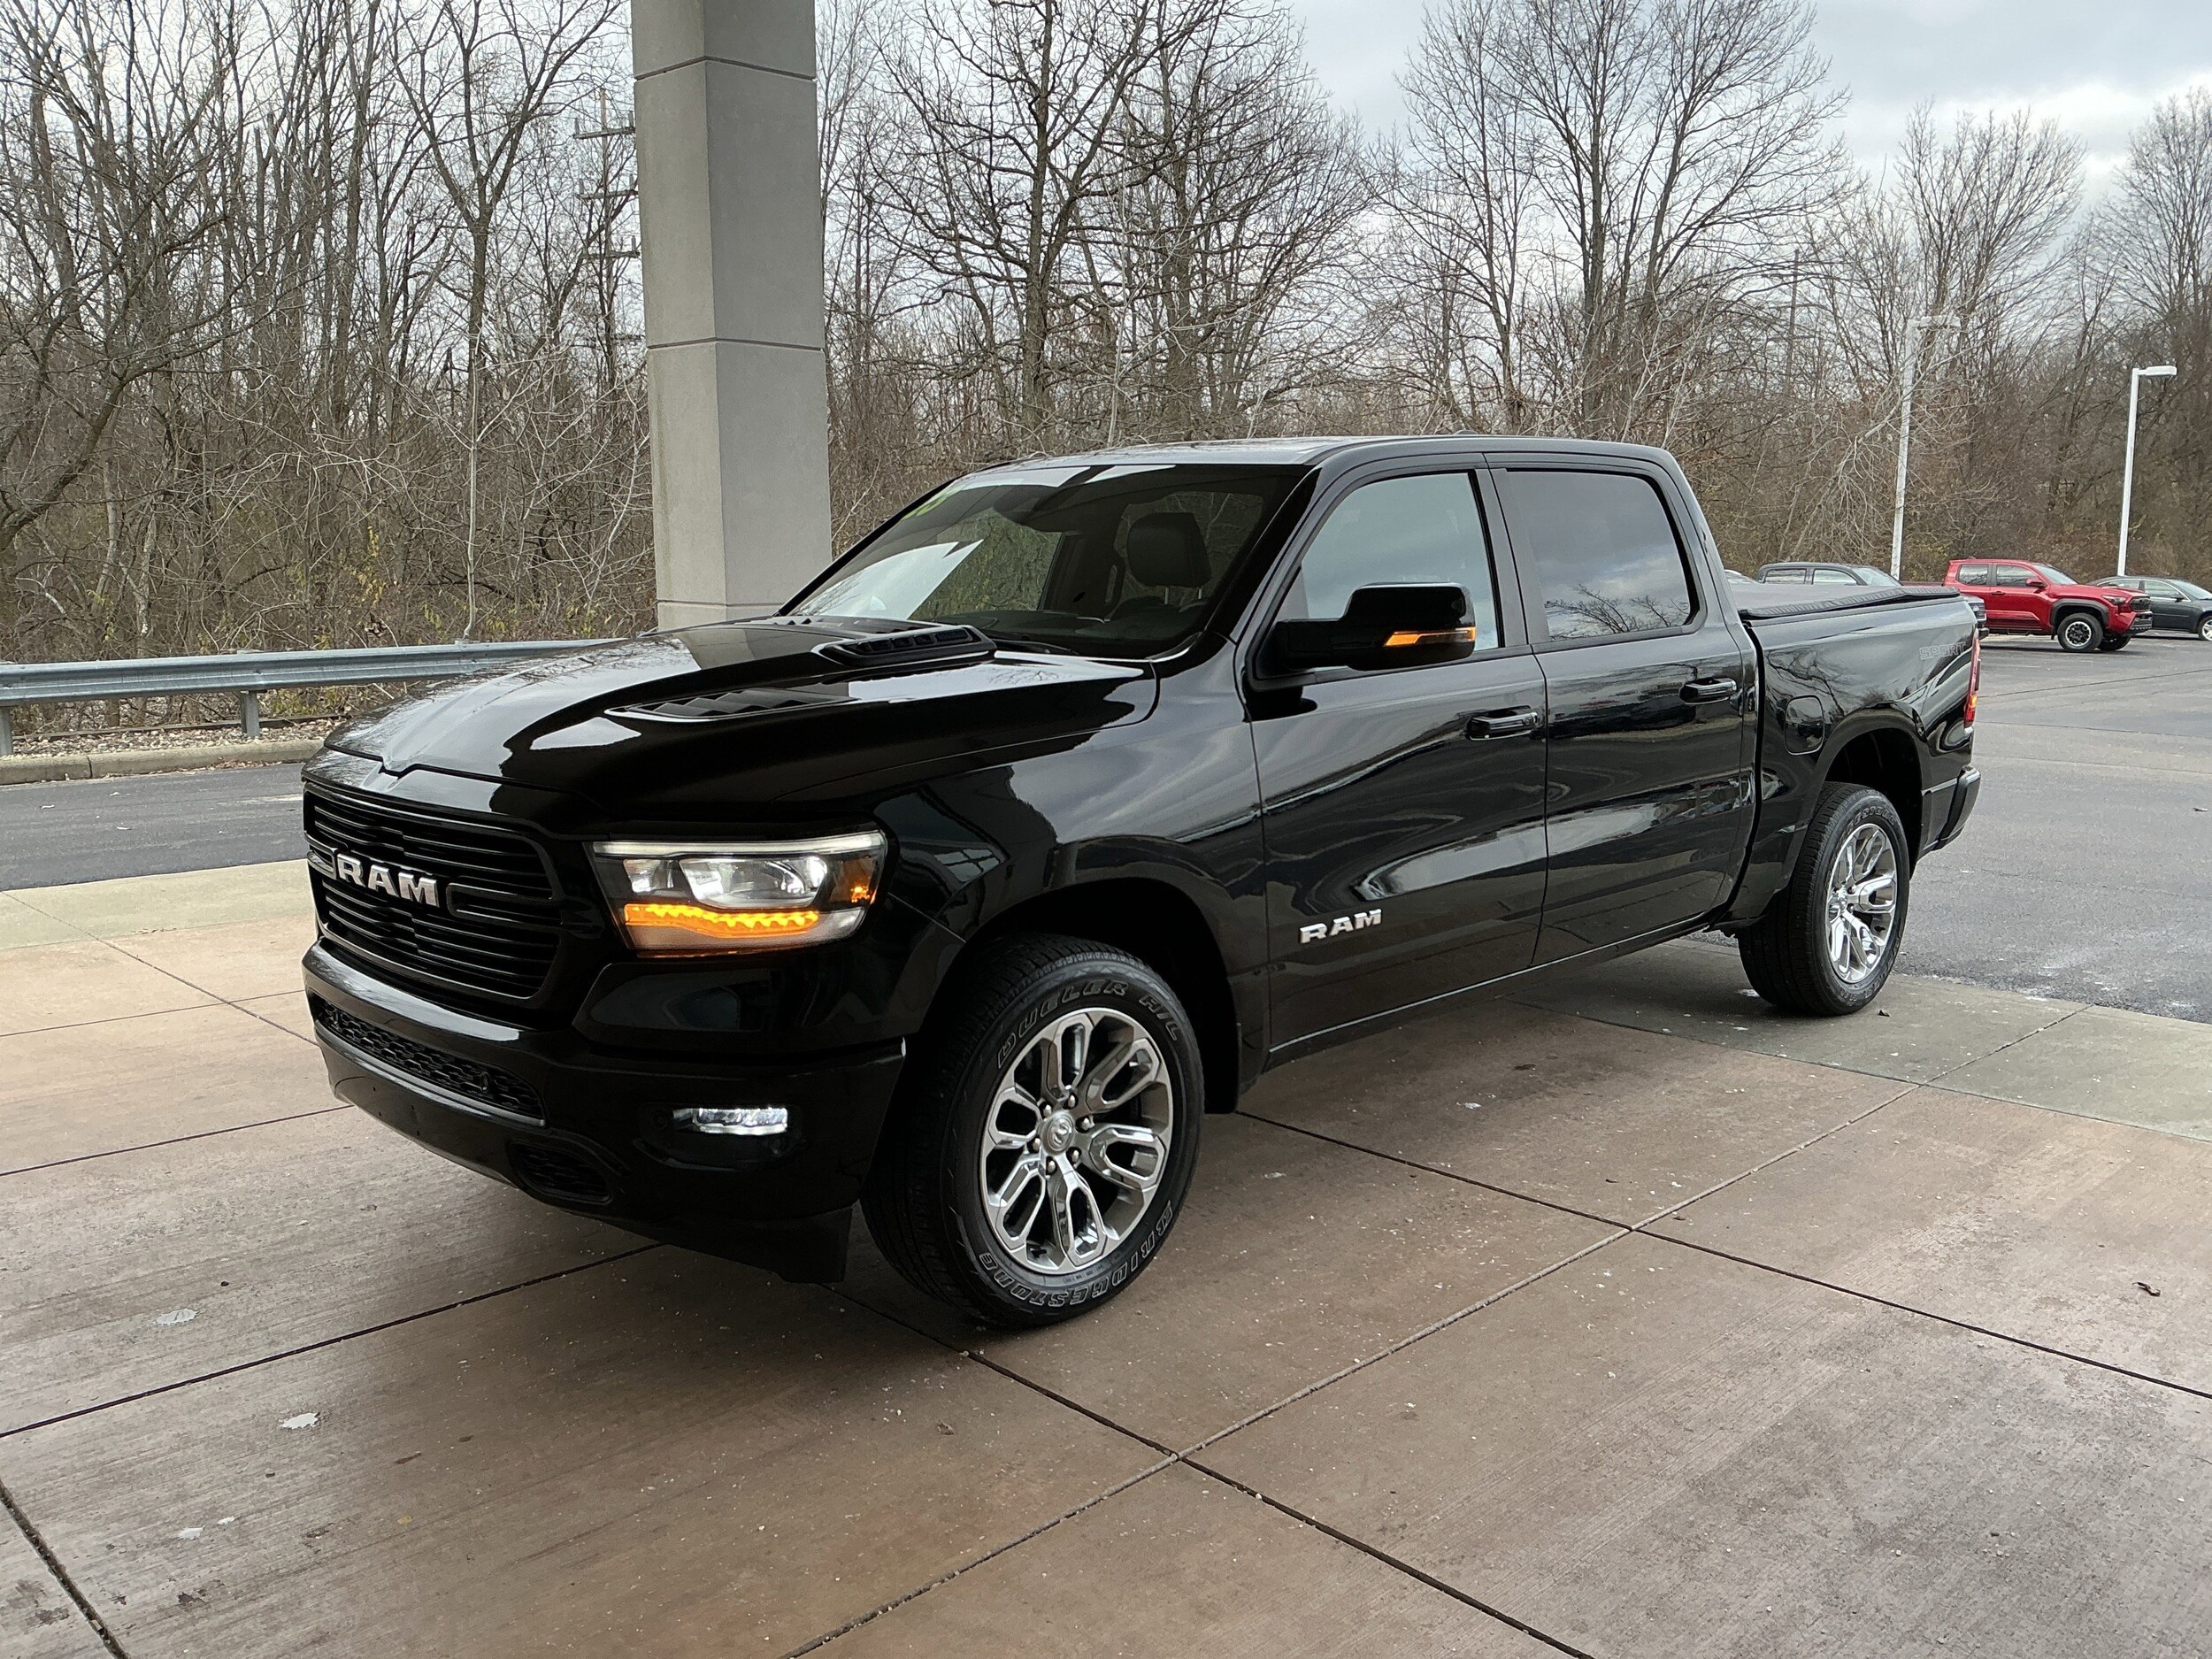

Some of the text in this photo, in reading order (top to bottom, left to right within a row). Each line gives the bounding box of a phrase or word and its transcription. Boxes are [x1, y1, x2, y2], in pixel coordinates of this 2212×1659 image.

[1919, 641, 1966, 660] SPORT
[337, 853, 439, 908] RAM
[1300, 909, 1382, 944] RAM
[997, 979, 1129, 1069] DUELER
[979, 1200, 1173, 1307] BRIDGESTONE
